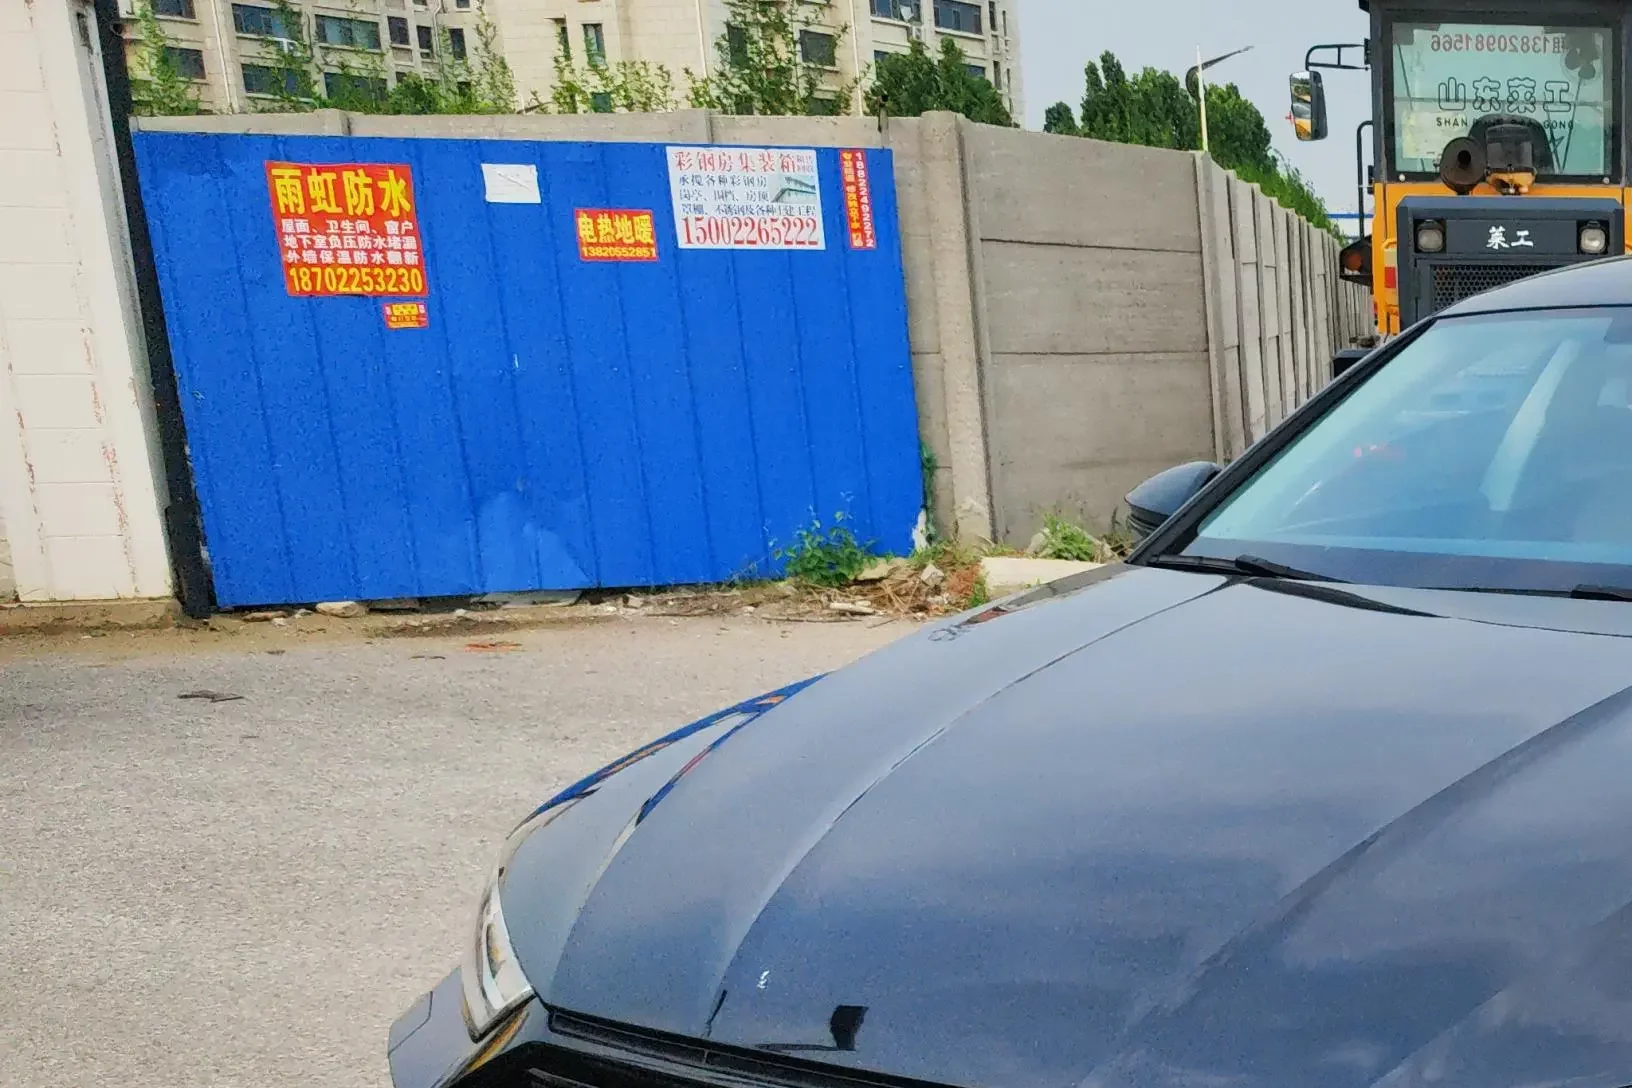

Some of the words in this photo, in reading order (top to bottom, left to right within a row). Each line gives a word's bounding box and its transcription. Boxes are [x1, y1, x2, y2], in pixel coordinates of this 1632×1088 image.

[675, 151, 796, 173] 彩钢房集装箱
[271, 168, 411, 217] 雨虹防水
[578, 211, 654, 245] 电热地暖
[682, 216, 818, 245] 15002265222
[284, 235, 417, 250] 地下室负压防水堵漏
[287, 250, 419, 265] 外墙保温防水翻新
[289, 267, 422, 292] 18702253230
